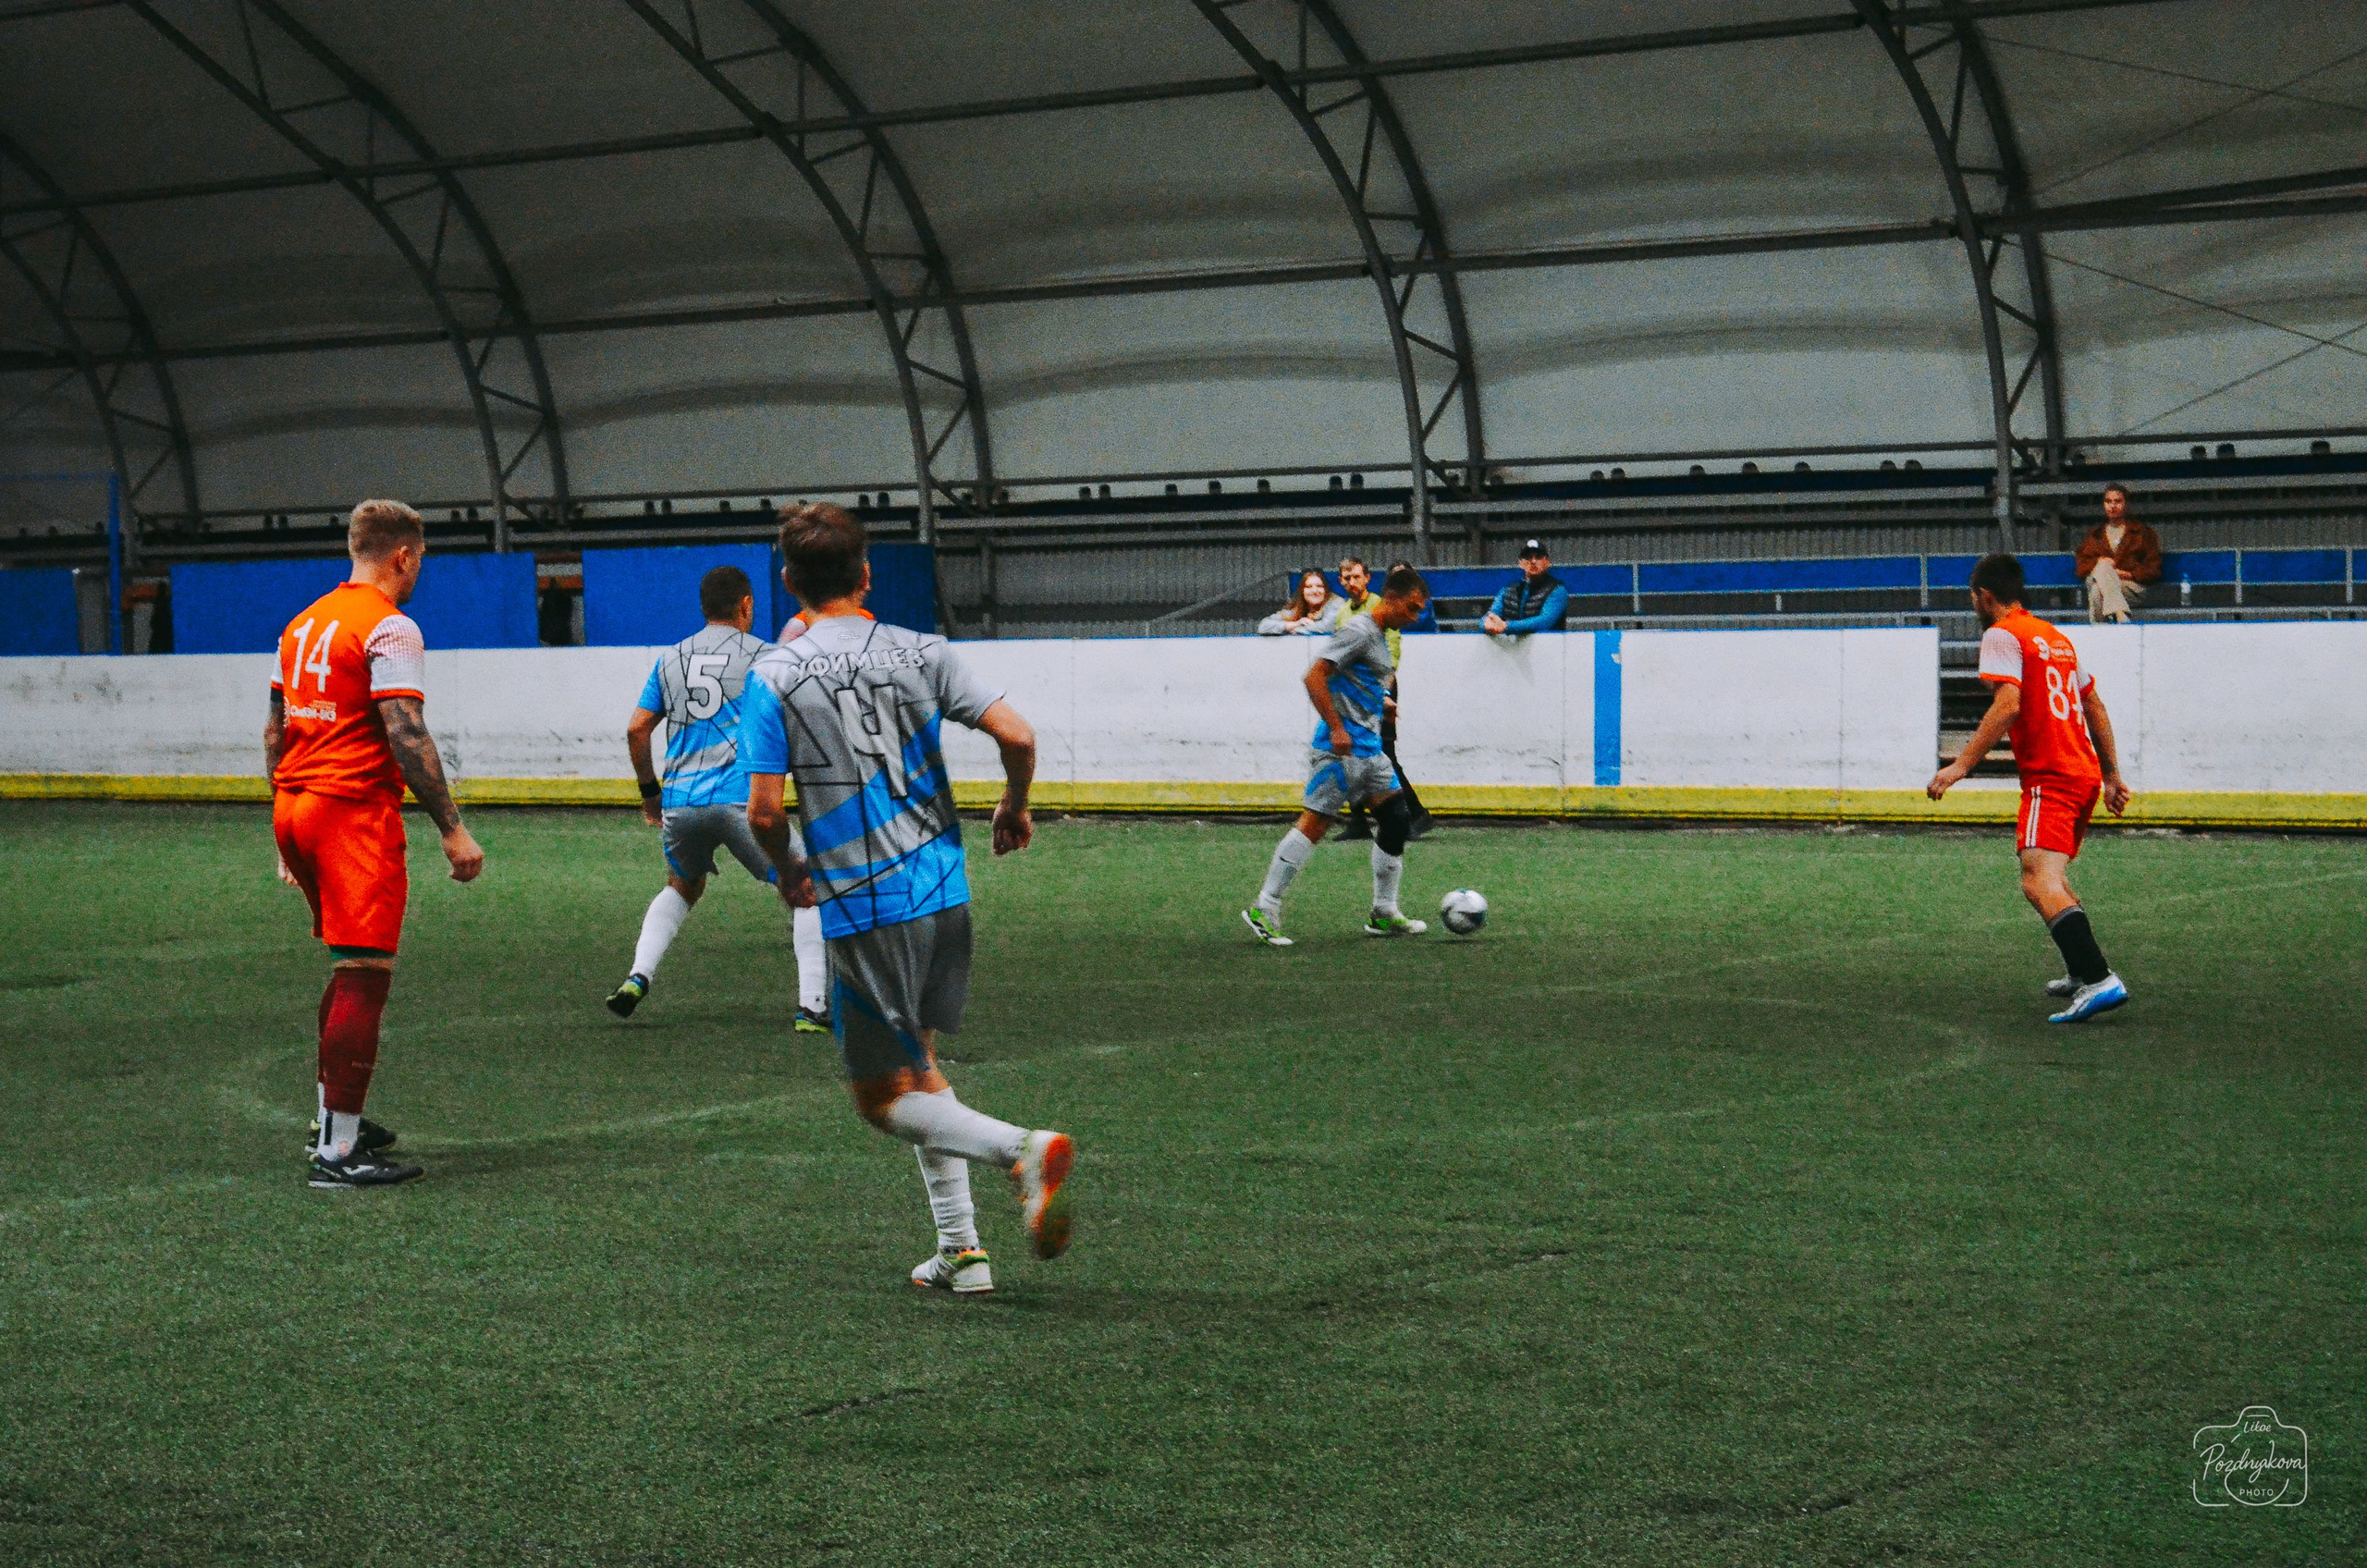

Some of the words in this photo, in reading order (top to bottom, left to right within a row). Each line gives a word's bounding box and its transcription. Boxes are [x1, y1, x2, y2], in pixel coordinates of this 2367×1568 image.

[291, 617, 340, 692] 14
[685, 653, 730, 719] 5
[787, 648, 926, 682] УФИМЦЕВ
[834, 683, 907, 798] 4
